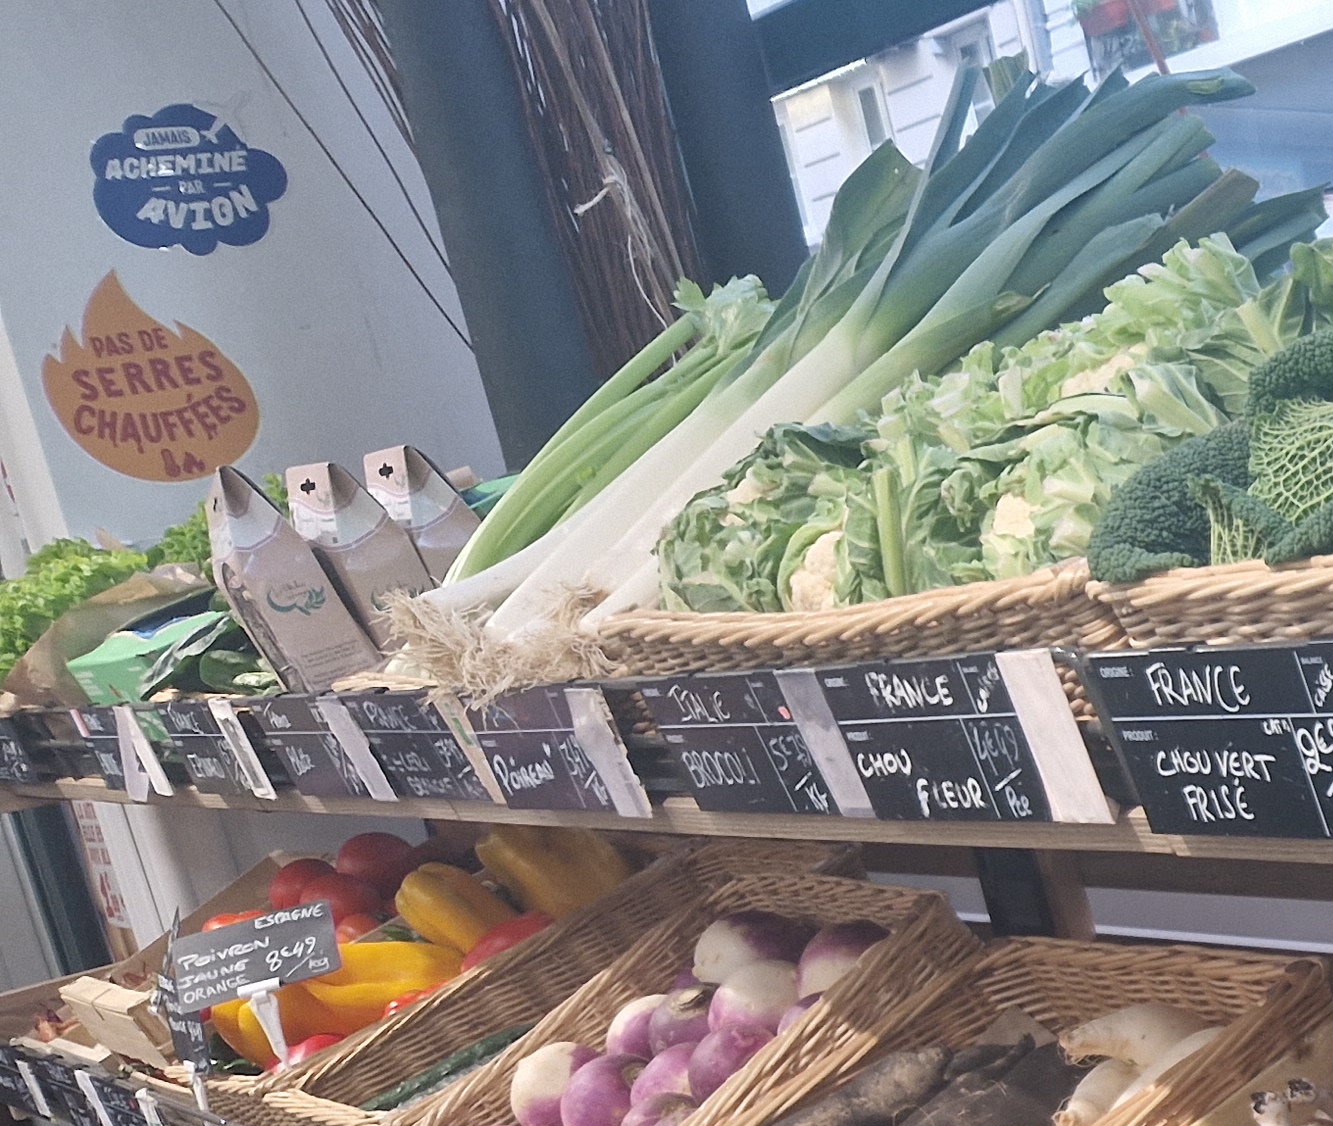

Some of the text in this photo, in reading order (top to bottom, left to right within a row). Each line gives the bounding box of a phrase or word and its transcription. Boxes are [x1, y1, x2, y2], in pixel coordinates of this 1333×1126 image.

[143, 131, 191, 146] JAMAIS
[178, 181, 205, 194] PAR
[136, 184, 258, 230] AVION
[89, 328, 168, 358] PAS DE
[72, 350, 224, 402] SERRES
[864, 671, 954, 713] FRANCE
[1145, 661, 1251, 713] FRANCE
[681, 747, 761, 789] BROCOLI
[856, 748, 912, 778] CHOU
[1155, 746, 1277, 783] CHOU VERT
[915, 777, 989, 819] FLEUR
[254, 903, 325, 929] ESPAGNE
[178, 936, 270, 971] POIVRON
[178, 958, 250, 989] JAUNE
[183, 974, 250, 1003] ORANGE
